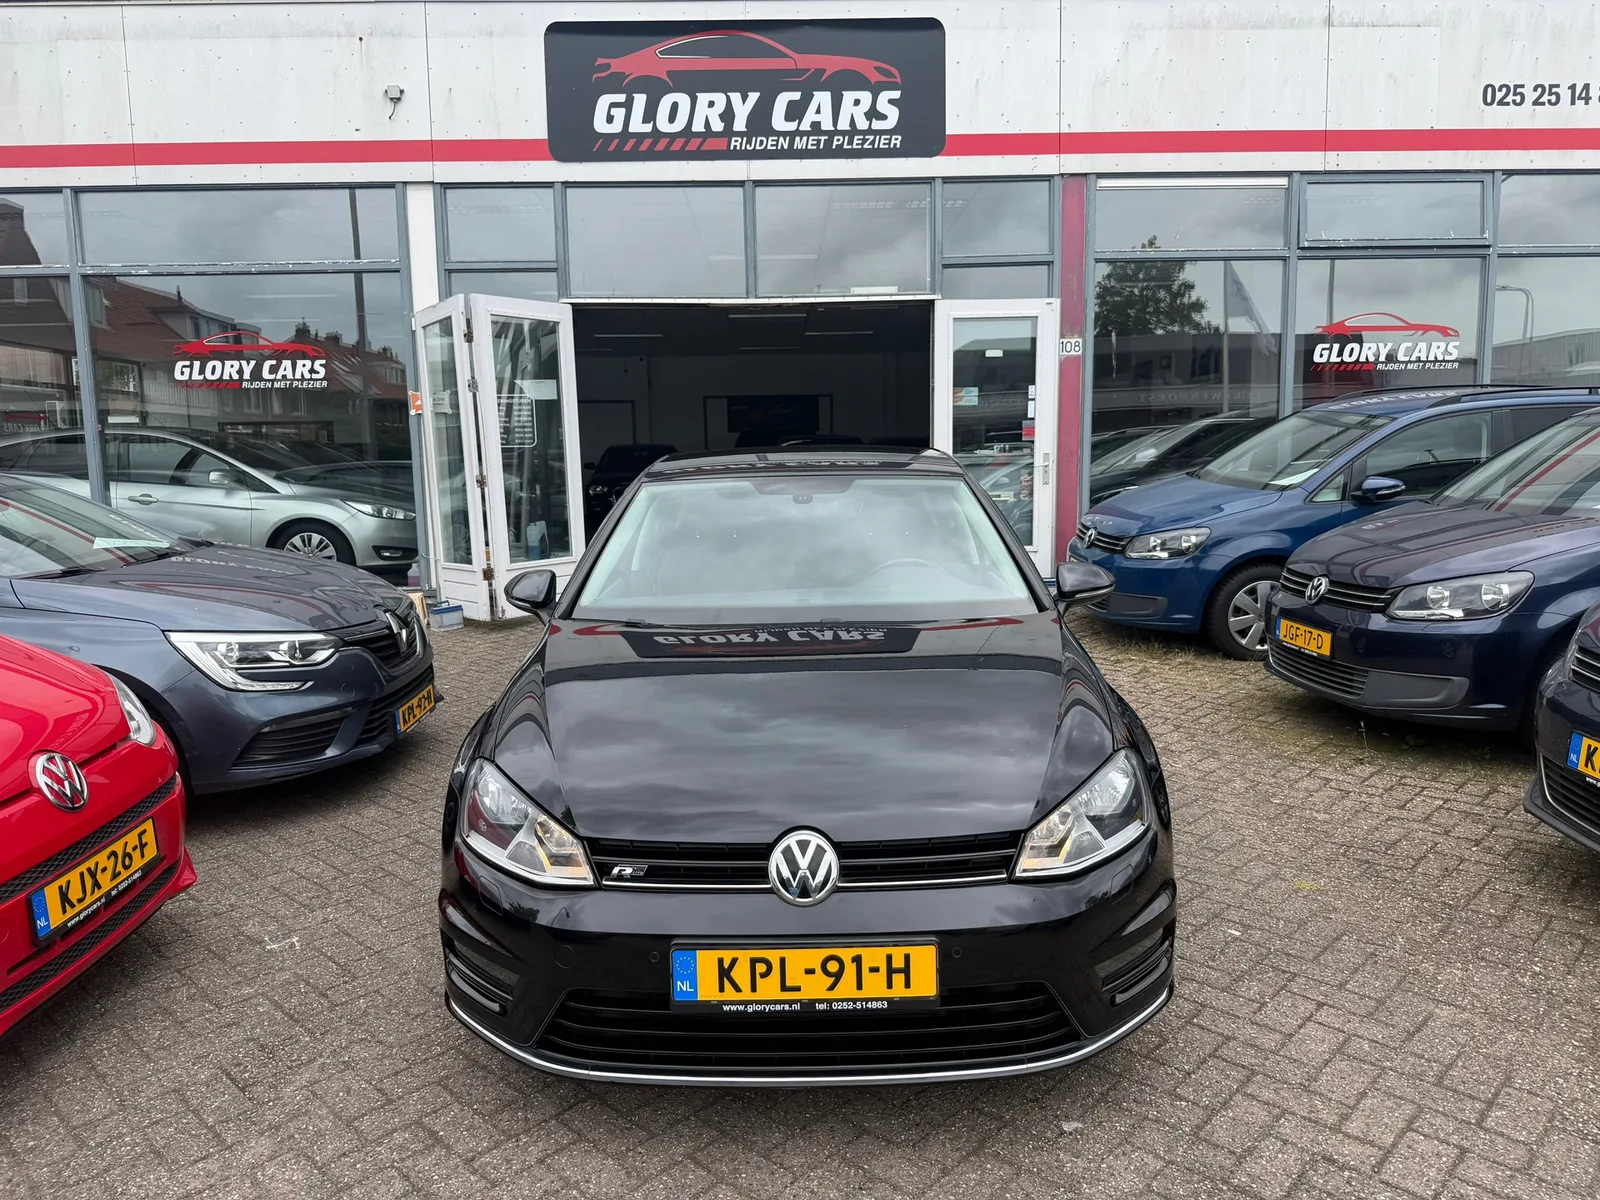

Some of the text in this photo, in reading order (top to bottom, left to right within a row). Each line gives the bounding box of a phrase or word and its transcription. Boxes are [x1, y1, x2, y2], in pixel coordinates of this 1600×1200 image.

[1482, 83, 1526, 107] 025
[1531, 83, 1561, 107] 25
[1567, 82, 1592, 106] 14
[592, 90, 902, 134] GLORY CARS
[730, 135, 902, 151] RIJDEN MET PLEZIER
[1060, 340, 1081, 354] 108
[1313, 341, 1460, 363] GLORY CARS
[173, 359, 327, 380] GLORY CARS
[1425, 362, 1459, 370] PLEZIER
[242, 380, 328, 389] RIJDEN MET PLEZIER
[1283, 623, 1324, 650] JGF-17-D
[1584, 744, 1600, 773] K
[57, 828, 149, 916] KJX-26-F
[36, 916, 49, 930] NL
[717, 952, 912, 993] KPL-91-H
[676, 980, 695, 992] NL
[723, 1001, 888, 1012] www.glorycars.nl tel: 0252-514863
